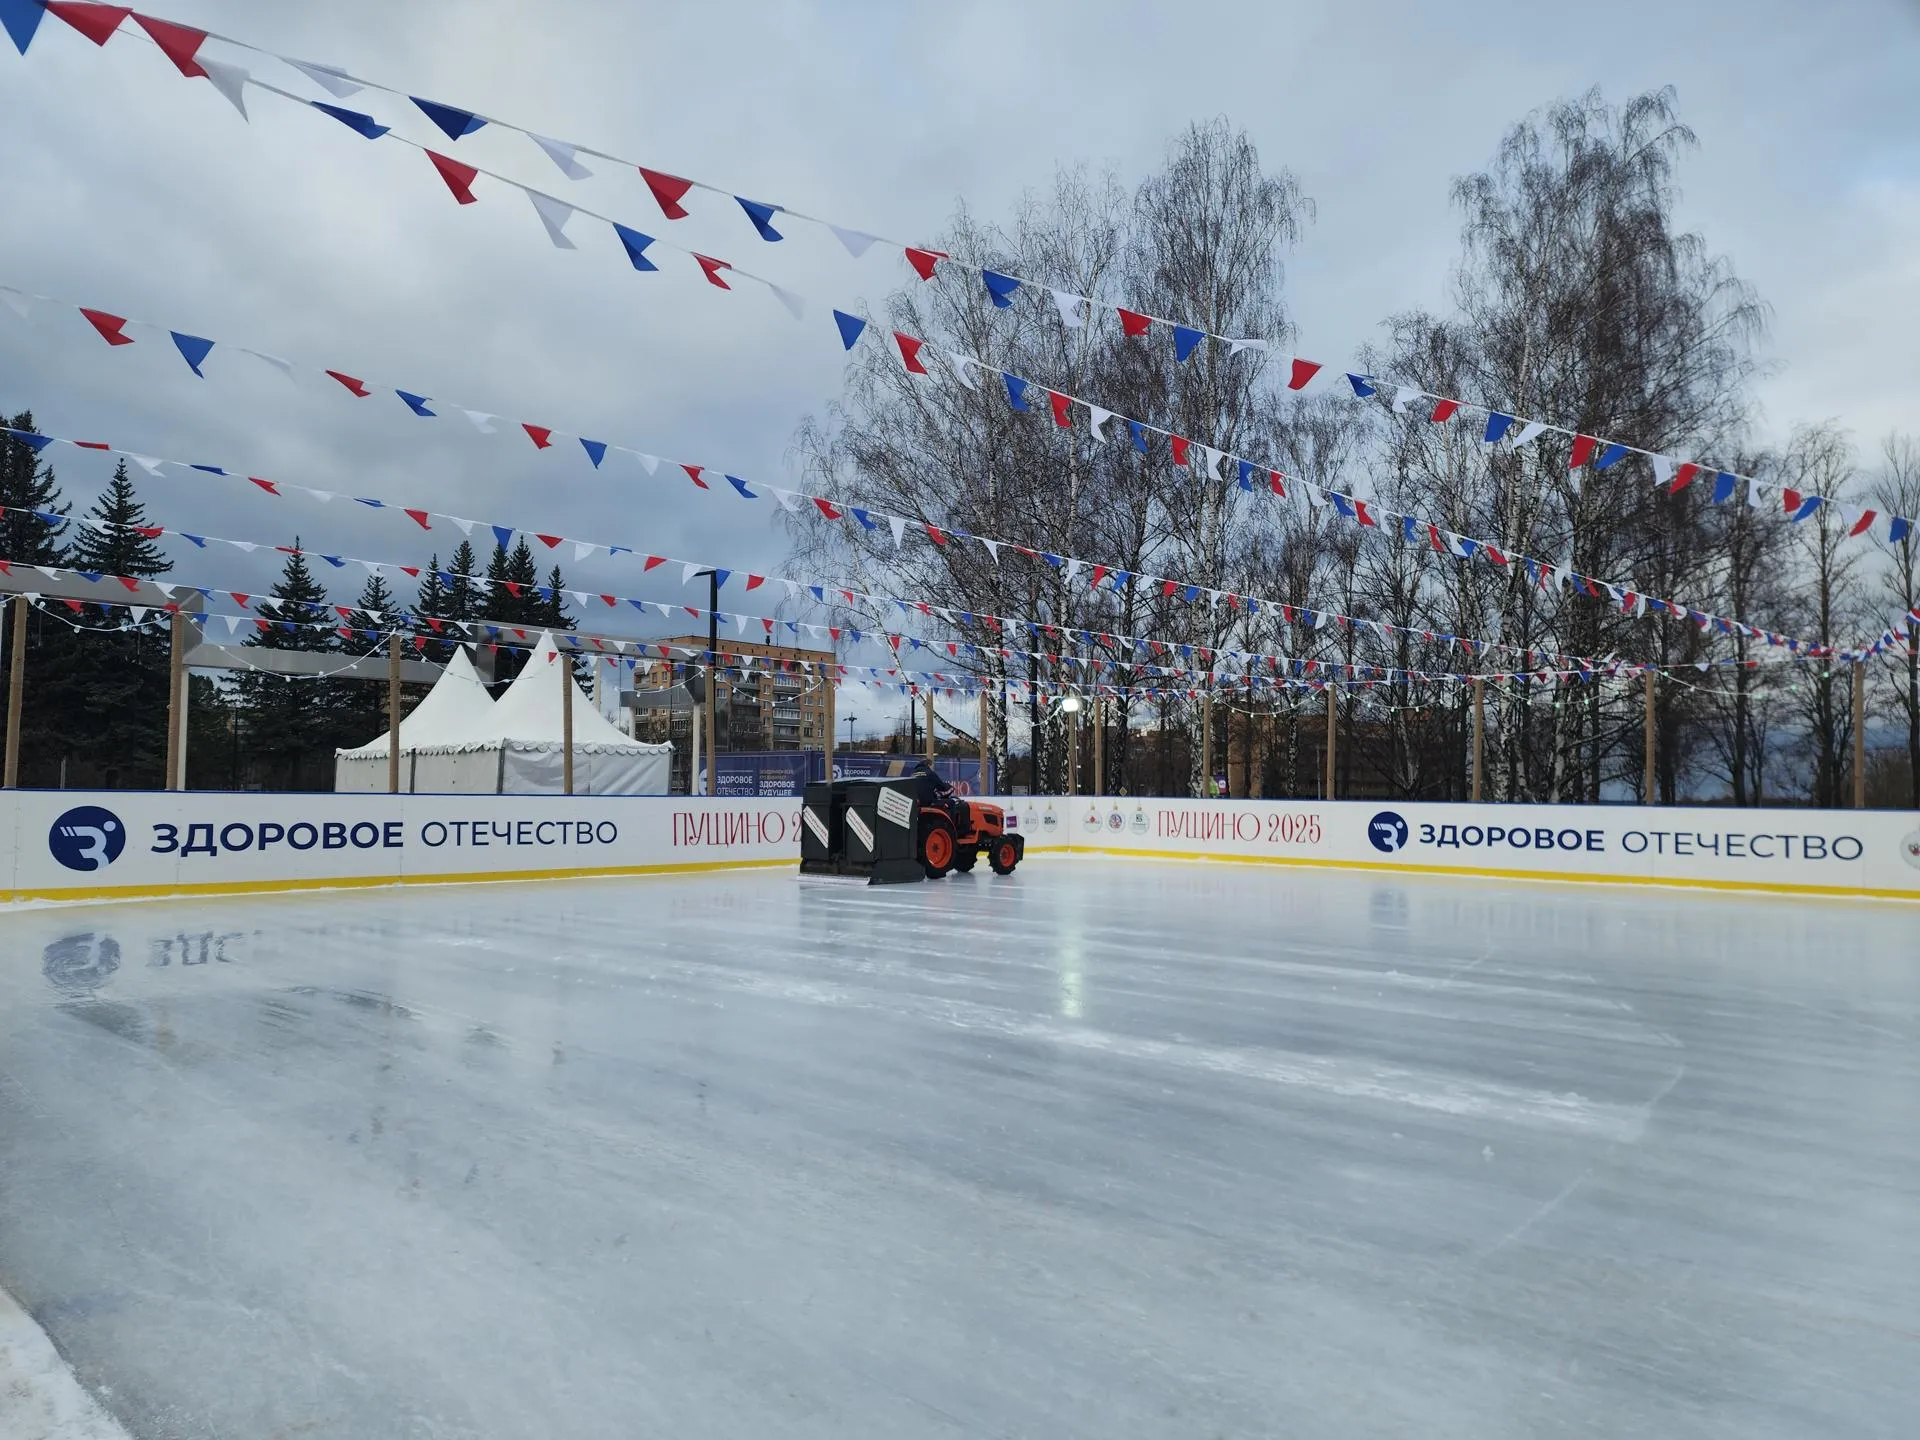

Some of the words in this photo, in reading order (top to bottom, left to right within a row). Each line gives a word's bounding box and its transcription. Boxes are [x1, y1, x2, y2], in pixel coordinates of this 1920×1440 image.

[716, 787, 755, 796] ОТЕЧЕСТВО
[717, 775, 753, 784] ЗДОРОВОЕ
[759, 780, 796, 789] ЗДОРОВОЕ
[151, 821, 404, 858] ЗДОРОВОЕ
[420, 820, 619, 848] ОТЕЧЕСТВО
[673, 813, 785, 846] ПУЩИНО
[1157, 811, 1262, 842] ПУЩИНО
[1268, 814, 1322, 844] 2025
[1419, 823, 1605, 852] ЗДОРОВОЕ
[1621, 830, 1865, 861] ОТЕЧЕСТВО
